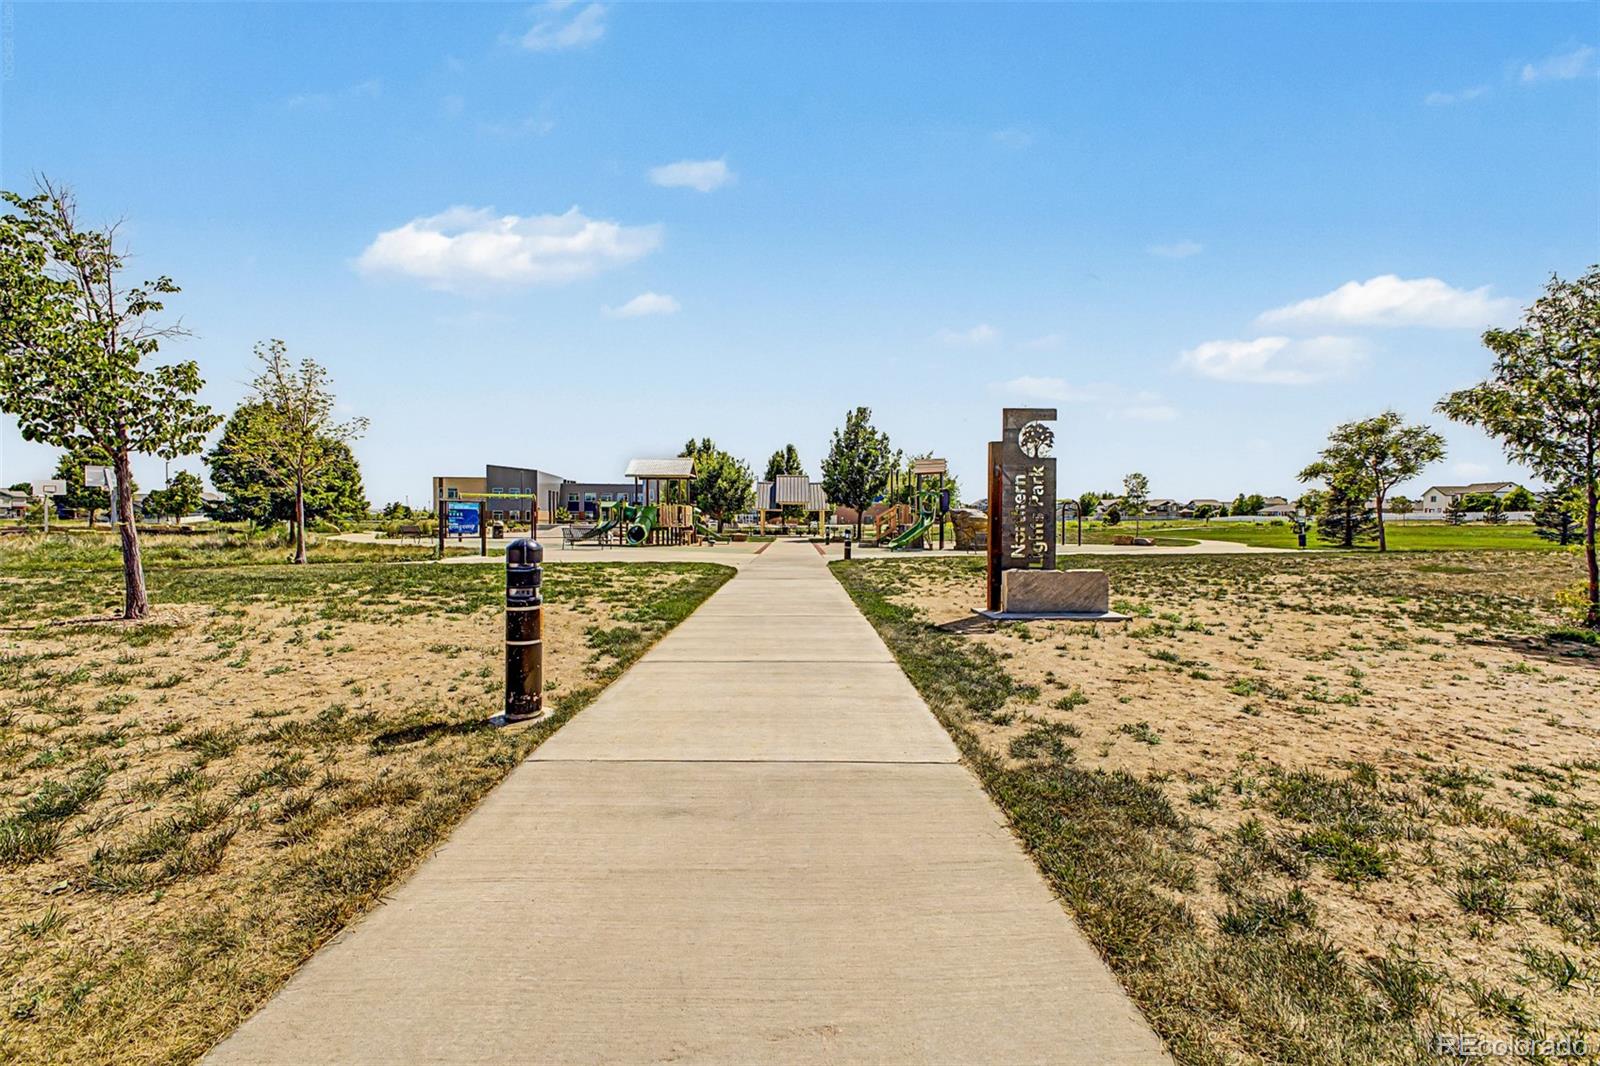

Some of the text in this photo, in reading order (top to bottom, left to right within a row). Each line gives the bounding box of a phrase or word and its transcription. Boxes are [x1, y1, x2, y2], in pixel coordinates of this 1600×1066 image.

[1010, 474, 1027, 558] Northern
[1028, 465, 1048, 568] Lights Park
